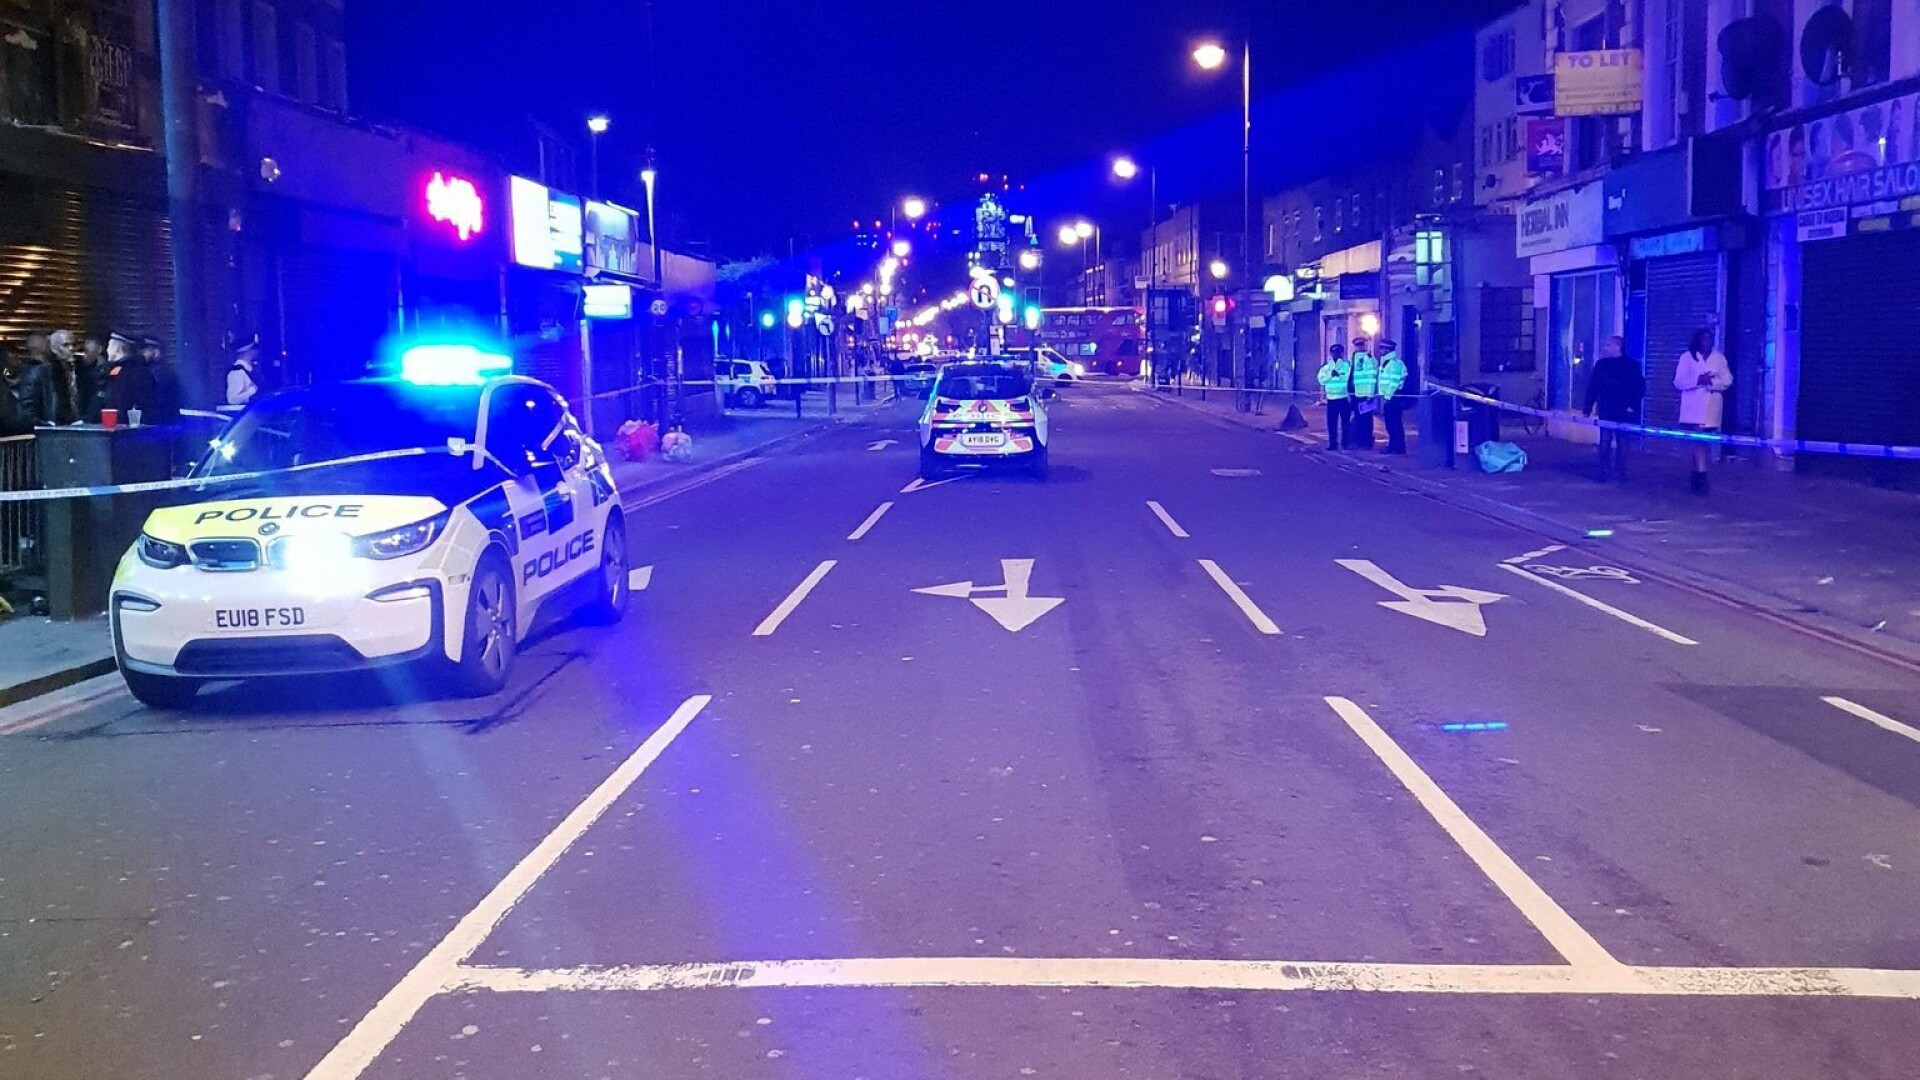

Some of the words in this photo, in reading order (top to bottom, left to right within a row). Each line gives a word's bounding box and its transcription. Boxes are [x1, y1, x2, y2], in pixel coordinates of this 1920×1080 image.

[1567, 54, 1594, 69] TO
[1599, 52, 1630, 67] LET
[194, 504, 364, 525] POLICE
[523, 528, 595, 587] POLICE
[215, 608, 260, 628] EU18
[264, 607, 305, 627] FSD
